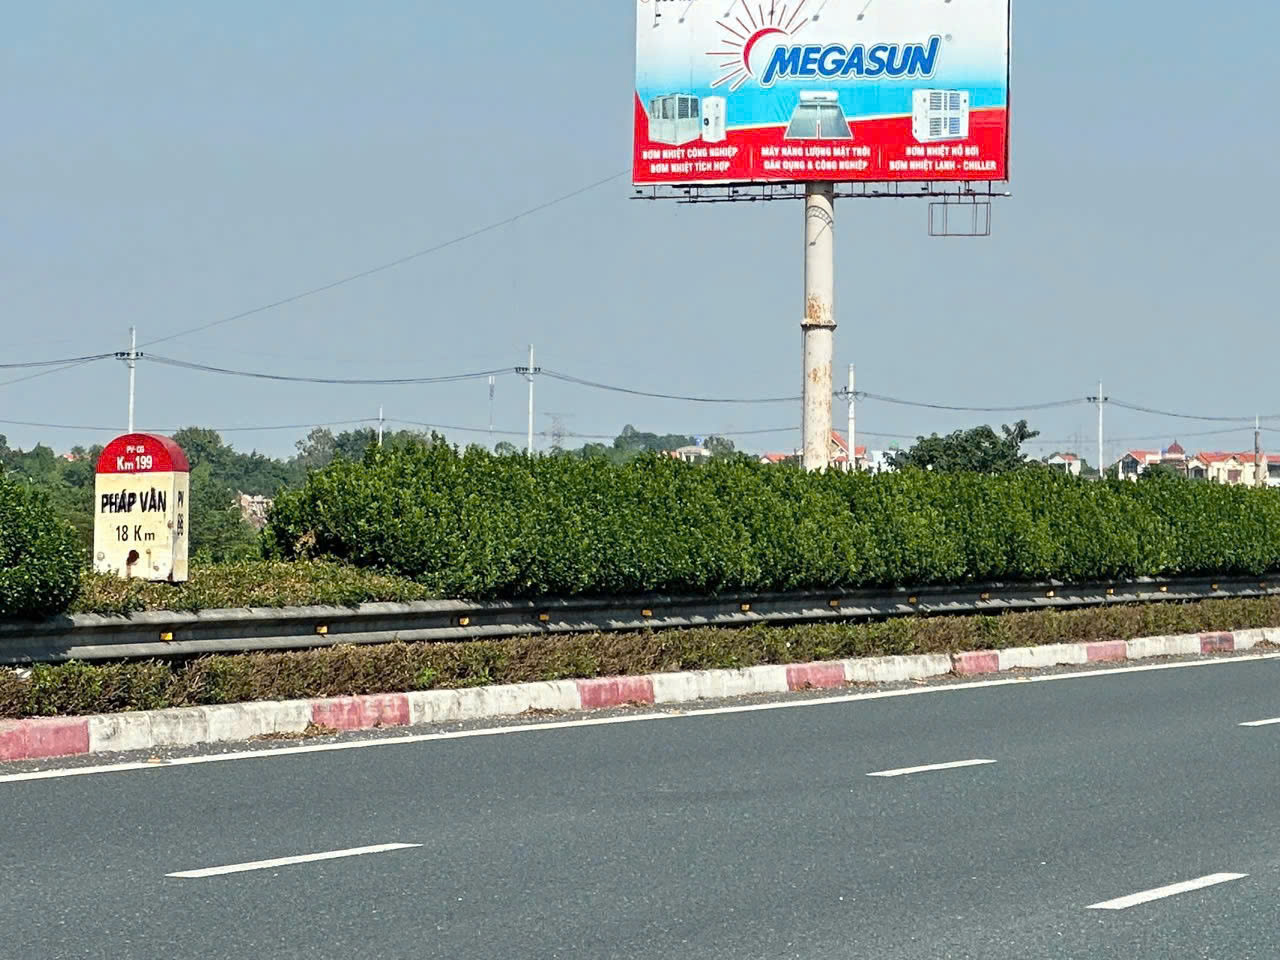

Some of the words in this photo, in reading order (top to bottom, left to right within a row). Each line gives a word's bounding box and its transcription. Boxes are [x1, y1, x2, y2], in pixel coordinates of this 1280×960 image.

[762, 36, 940, 84] MEGASUN
[963, 160, 997, 170] CHILLER
[117, 456, 134, 471] Km
[135, 455, 153, 470] 199
[101, 489, 137, 513] PHÁP
[139, 487, 167, 513] VÂN
[115, 525, 129, 541] 18
